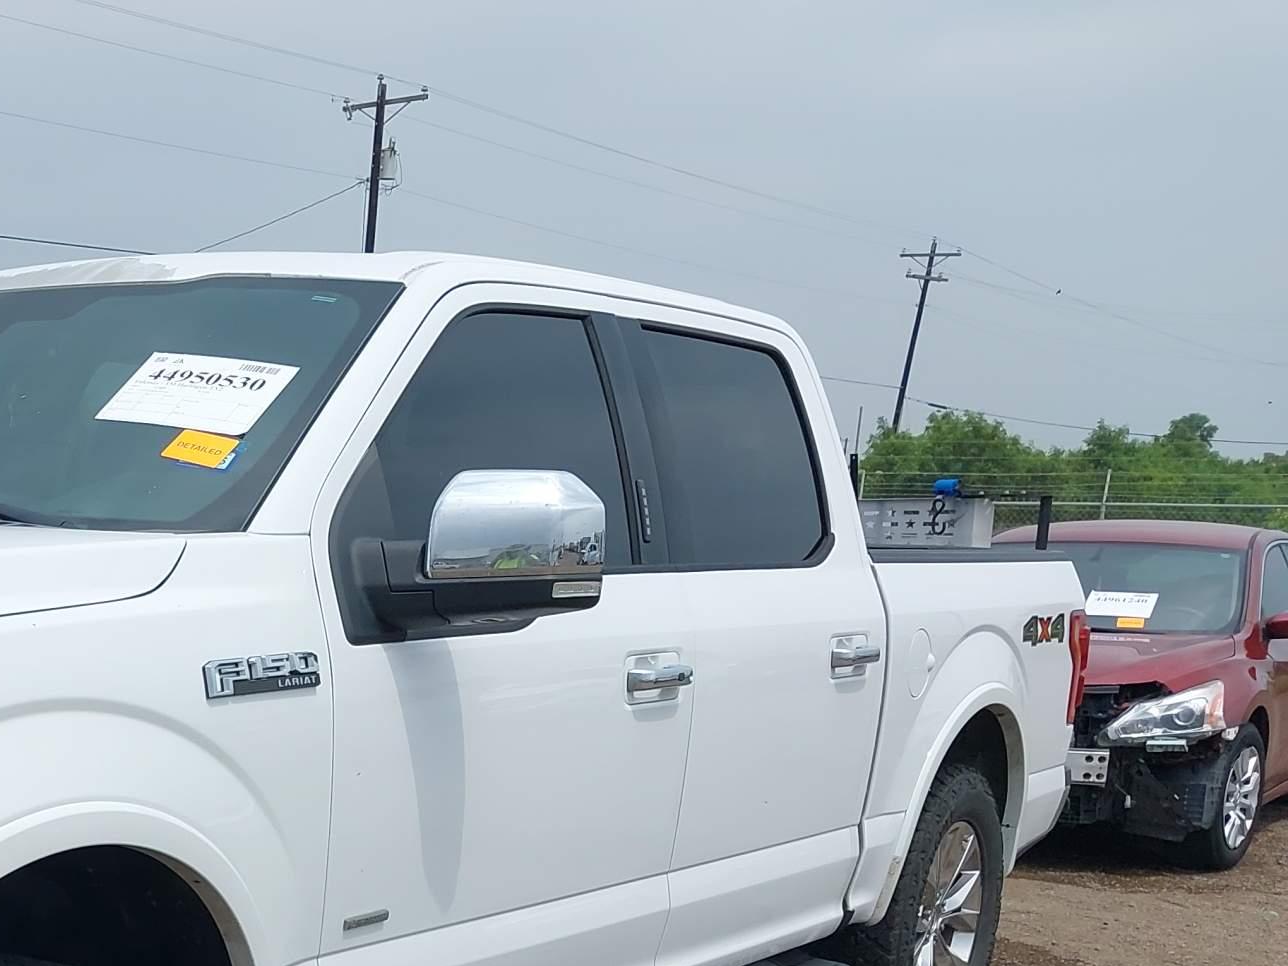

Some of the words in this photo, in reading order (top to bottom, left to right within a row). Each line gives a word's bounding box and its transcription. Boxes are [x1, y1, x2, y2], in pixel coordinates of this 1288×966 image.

[148, 368, 267, 392] 44950530
[176, 441, 223, 456] DETAILED
[279, 675, 316, 688] LARIAT
